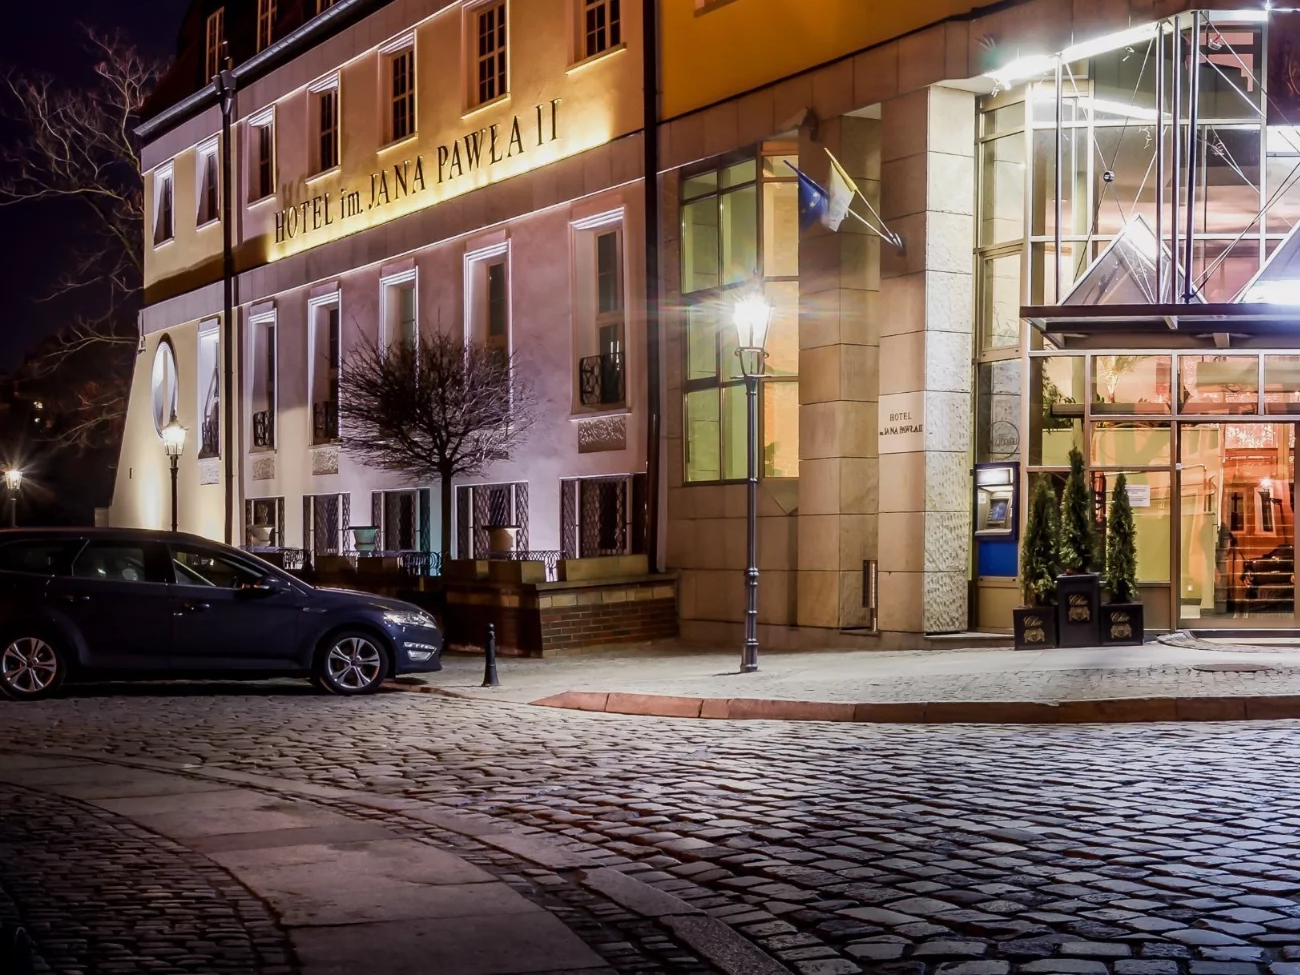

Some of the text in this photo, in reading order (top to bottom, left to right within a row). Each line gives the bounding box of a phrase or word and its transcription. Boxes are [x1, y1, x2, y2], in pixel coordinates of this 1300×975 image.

[274, 98, 562, 244] HOTEL im. JANA PAWŁA II
[889, 412, 912, 422] HOTEL
